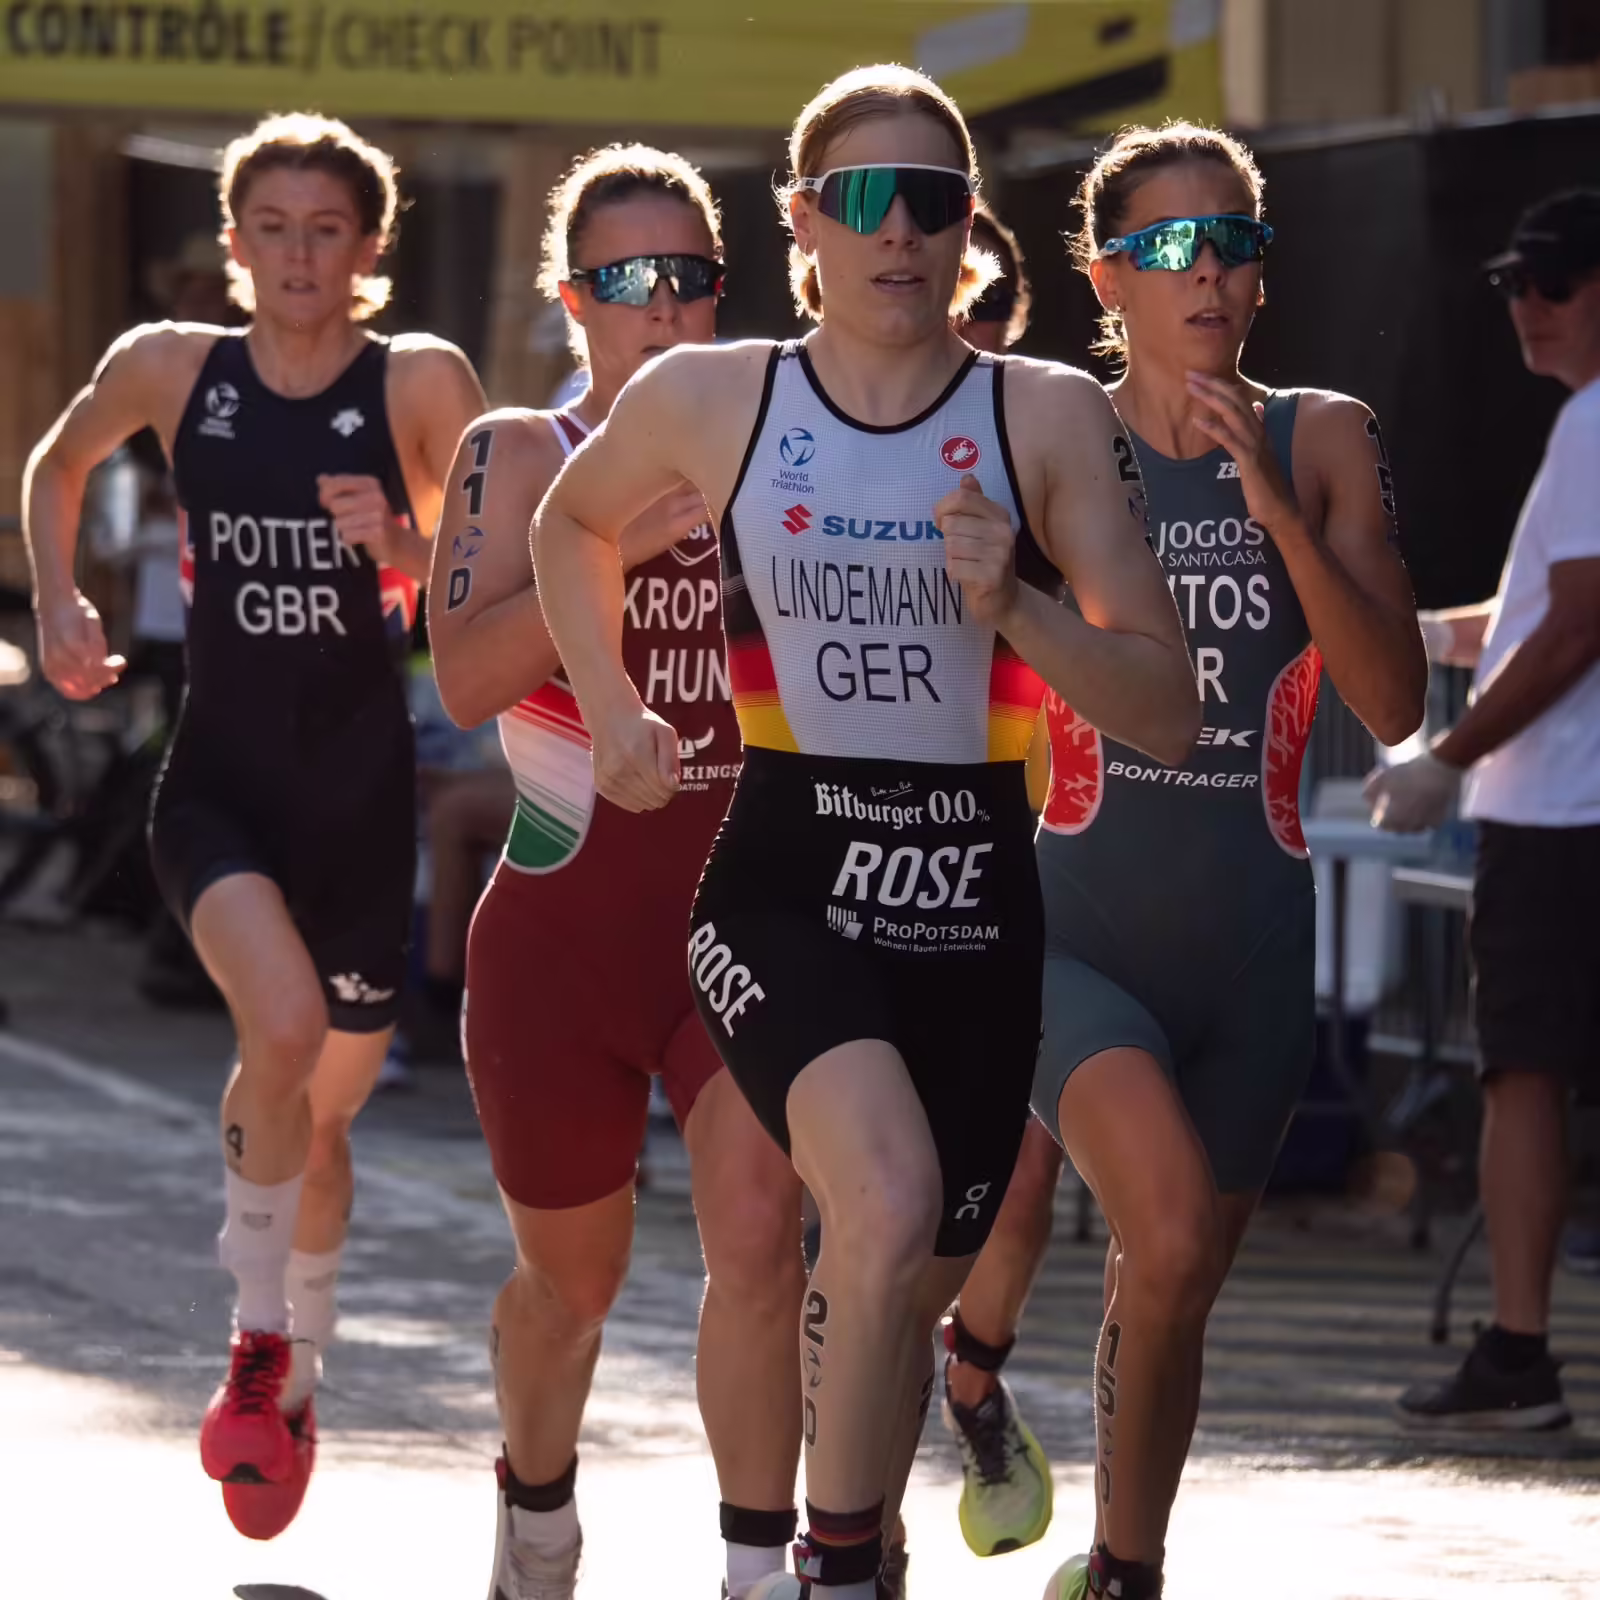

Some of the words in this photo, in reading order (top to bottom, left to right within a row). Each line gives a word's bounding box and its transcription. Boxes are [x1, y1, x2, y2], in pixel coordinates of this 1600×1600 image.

[507, 14, 665, 78] POINT
[779, 470, 809, 482] World
[1112, 434, 1142, 482] 2
[770, 478, 815, 494] Triathlon
[822, 514, 945, 542] SUZUK
[1156, 517, 1266, 558] JOGOS
[236, 580, 347, 636] GBR
[622, 576, 725, 632] KROP
[771, 554, 963, 627] LINDEMANN
[1166, 573, 1271, 631] TOS
[645, 648, 733, 705] HUN
[816, 640, 942, 704] GER
[1196, 727, 1259, 749] EK
[682, 763, 742, 781] KINGS
[1106, 761, 1259, 788] BONTRAGER
[814, 782, 924, 830] Bitburger
[831, 840, 994, 910] ROSE
[873, 936, 908, 951] Wohnen
[913, 944, 938, 953] Bauen
[943, 942, 987, 953] Entwickeln
[689, 921, 766, 1039] ROSE
